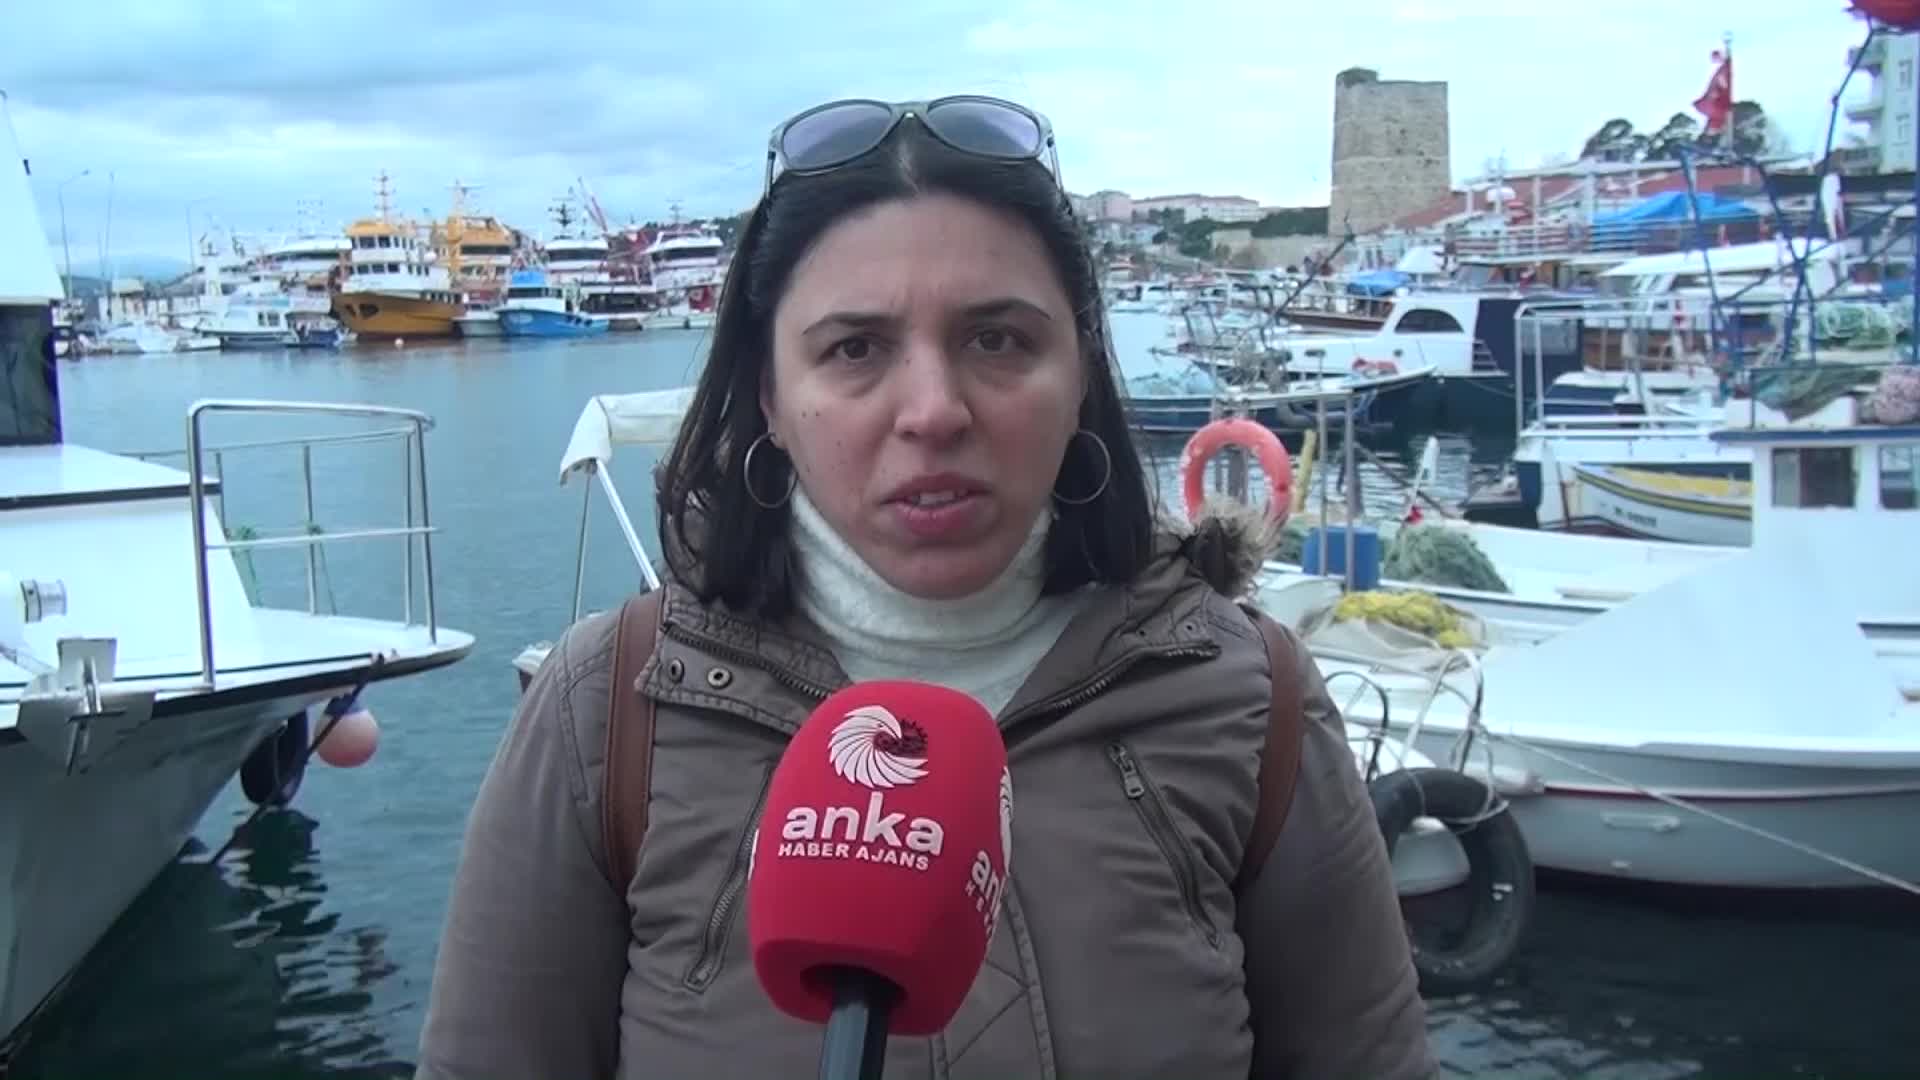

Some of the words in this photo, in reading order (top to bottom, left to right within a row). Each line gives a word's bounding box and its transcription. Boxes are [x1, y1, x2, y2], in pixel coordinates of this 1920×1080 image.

[782, 791, 944, 856] anka
[778, 842, 850, 858] HABER
[855, 845, 929, 871] AJANS
